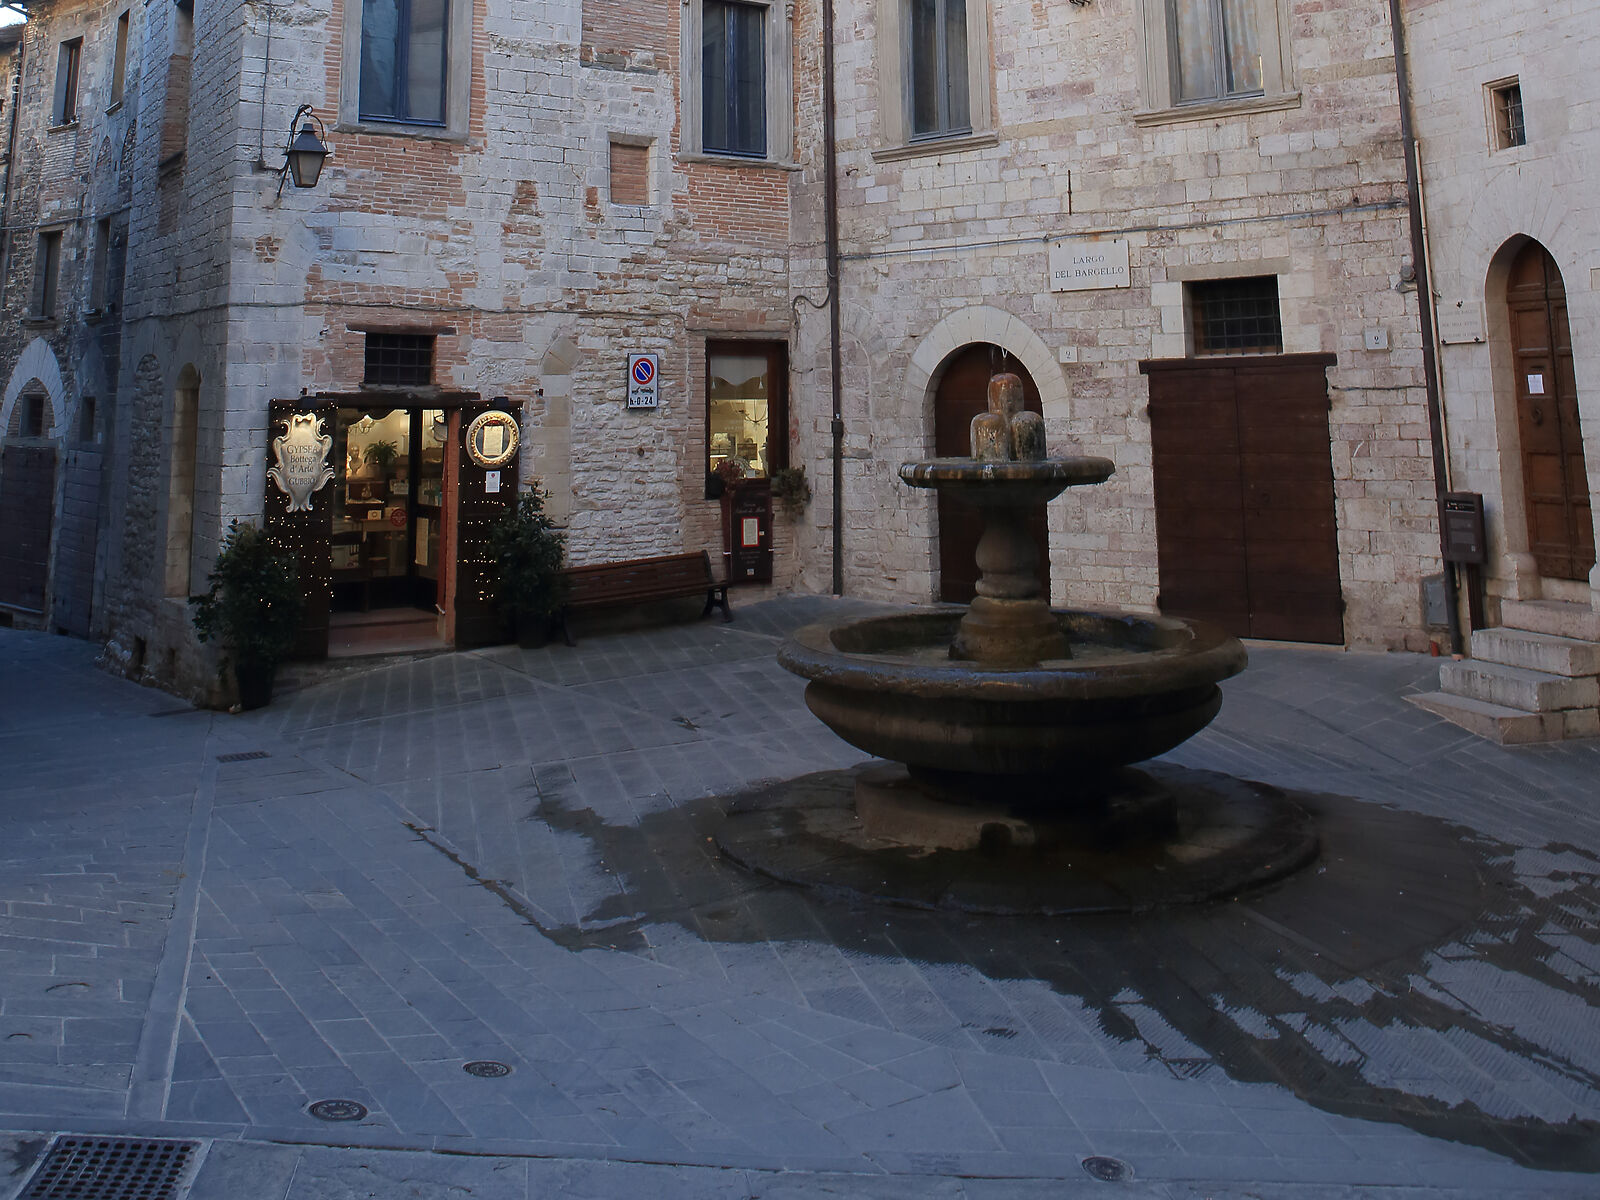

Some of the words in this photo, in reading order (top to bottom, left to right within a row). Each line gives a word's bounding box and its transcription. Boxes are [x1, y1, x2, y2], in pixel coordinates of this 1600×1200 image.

[1073, 255, 1104, 264] LARGO
[1055, 269, 1072, 279] DEL
[1075, 266, 1124, 277] BARGELLO
[1374, 336, 1379, 344] 2
[1066, 351, 1071, 359] 2
[287, 444, 318, 454] GYPSEA
[291, 455, 317, 465] Bottega
[288, 477, 316, 485] GUBBIO
